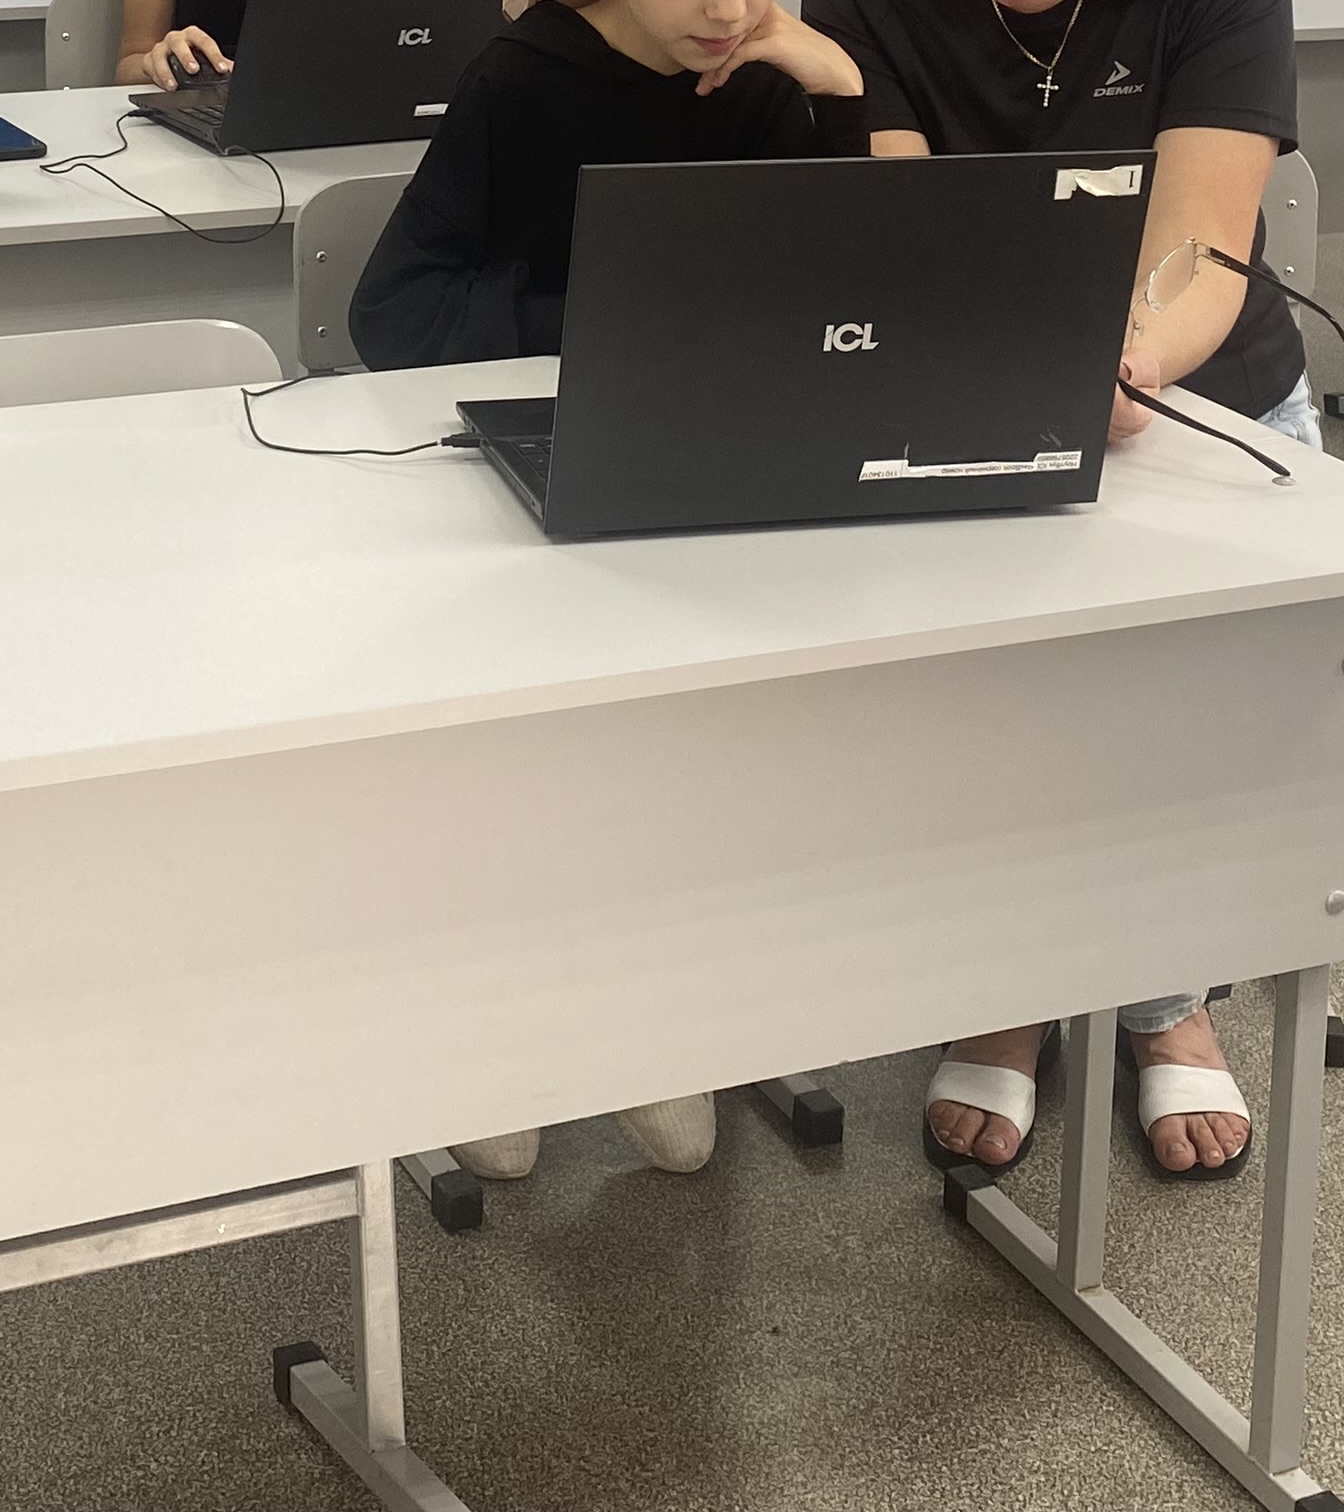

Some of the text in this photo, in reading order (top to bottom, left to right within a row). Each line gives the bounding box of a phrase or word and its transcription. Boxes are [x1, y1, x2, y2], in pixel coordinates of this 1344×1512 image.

[398, 28, 433, 46] ICL
[1092, 83, 1145, 98] DEMIX
[823, 323, 879, 352] ICL
